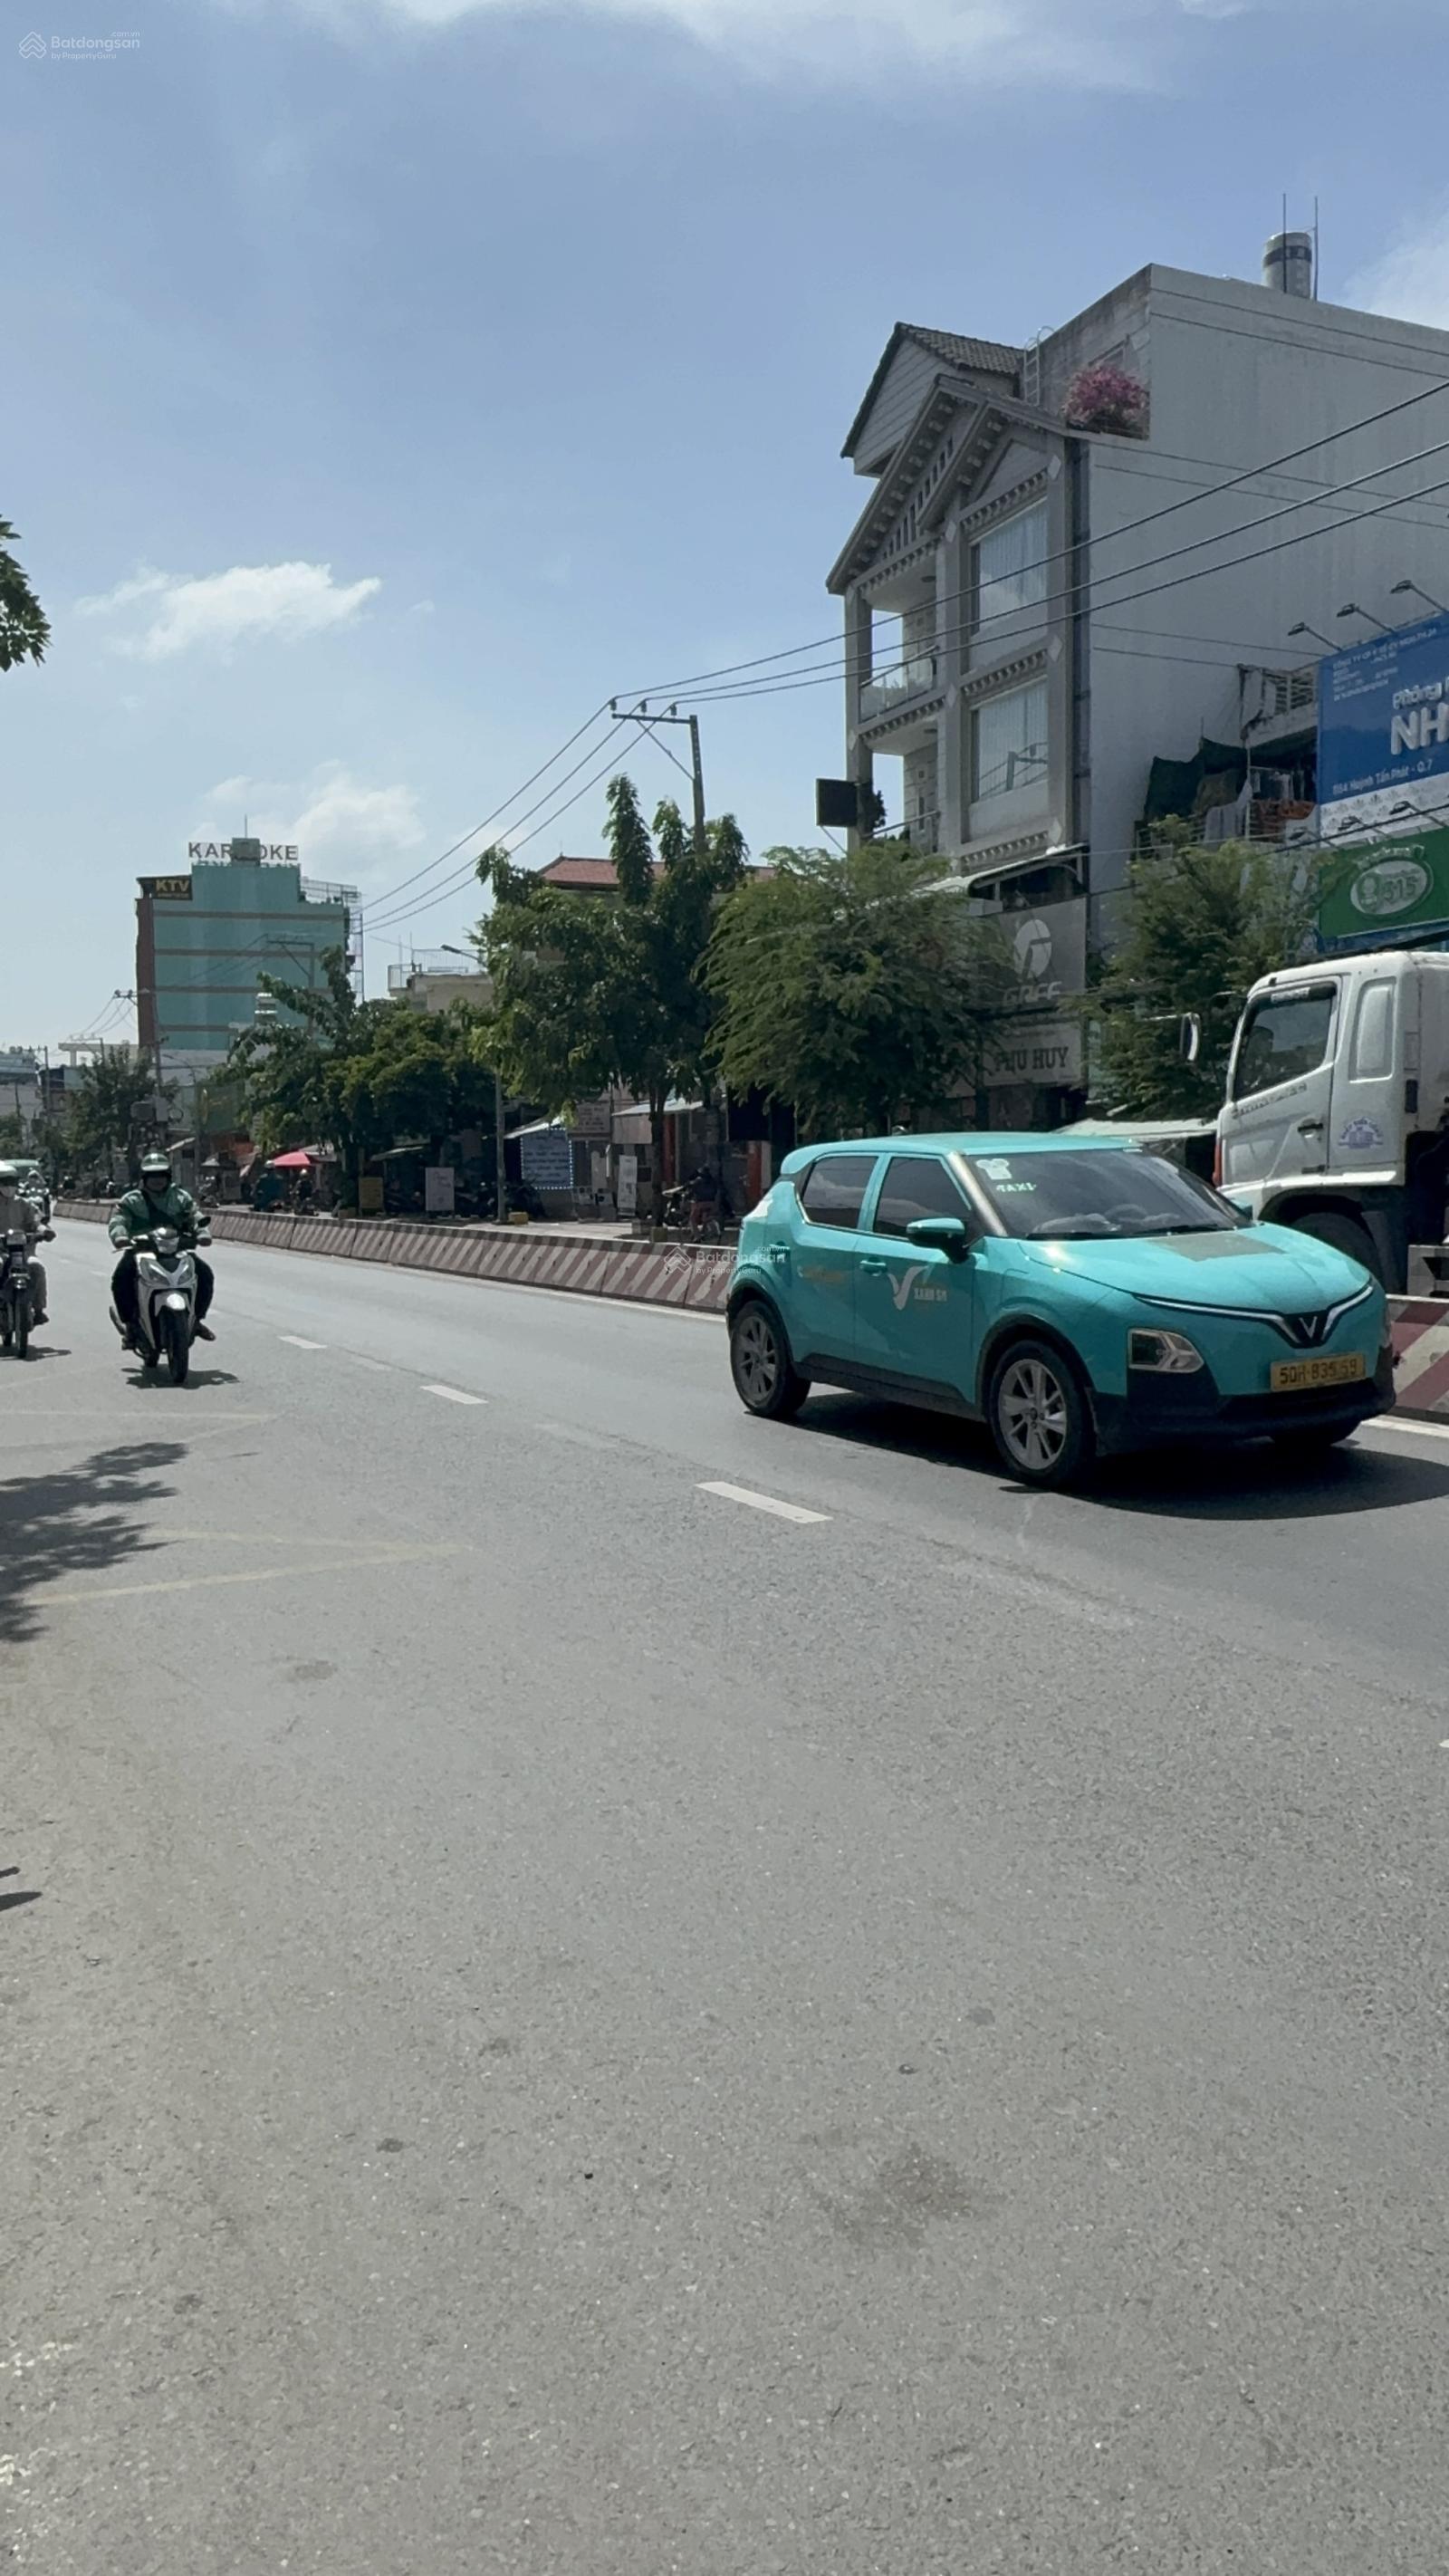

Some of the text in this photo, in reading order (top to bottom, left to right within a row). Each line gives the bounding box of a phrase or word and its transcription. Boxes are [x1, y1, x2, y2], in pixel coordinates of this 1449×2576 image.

[188, 841, 298, 860] KAROKE
[156, 879, 189, 892] KTV
[1032, 1047, 1069, 1070] HUY
